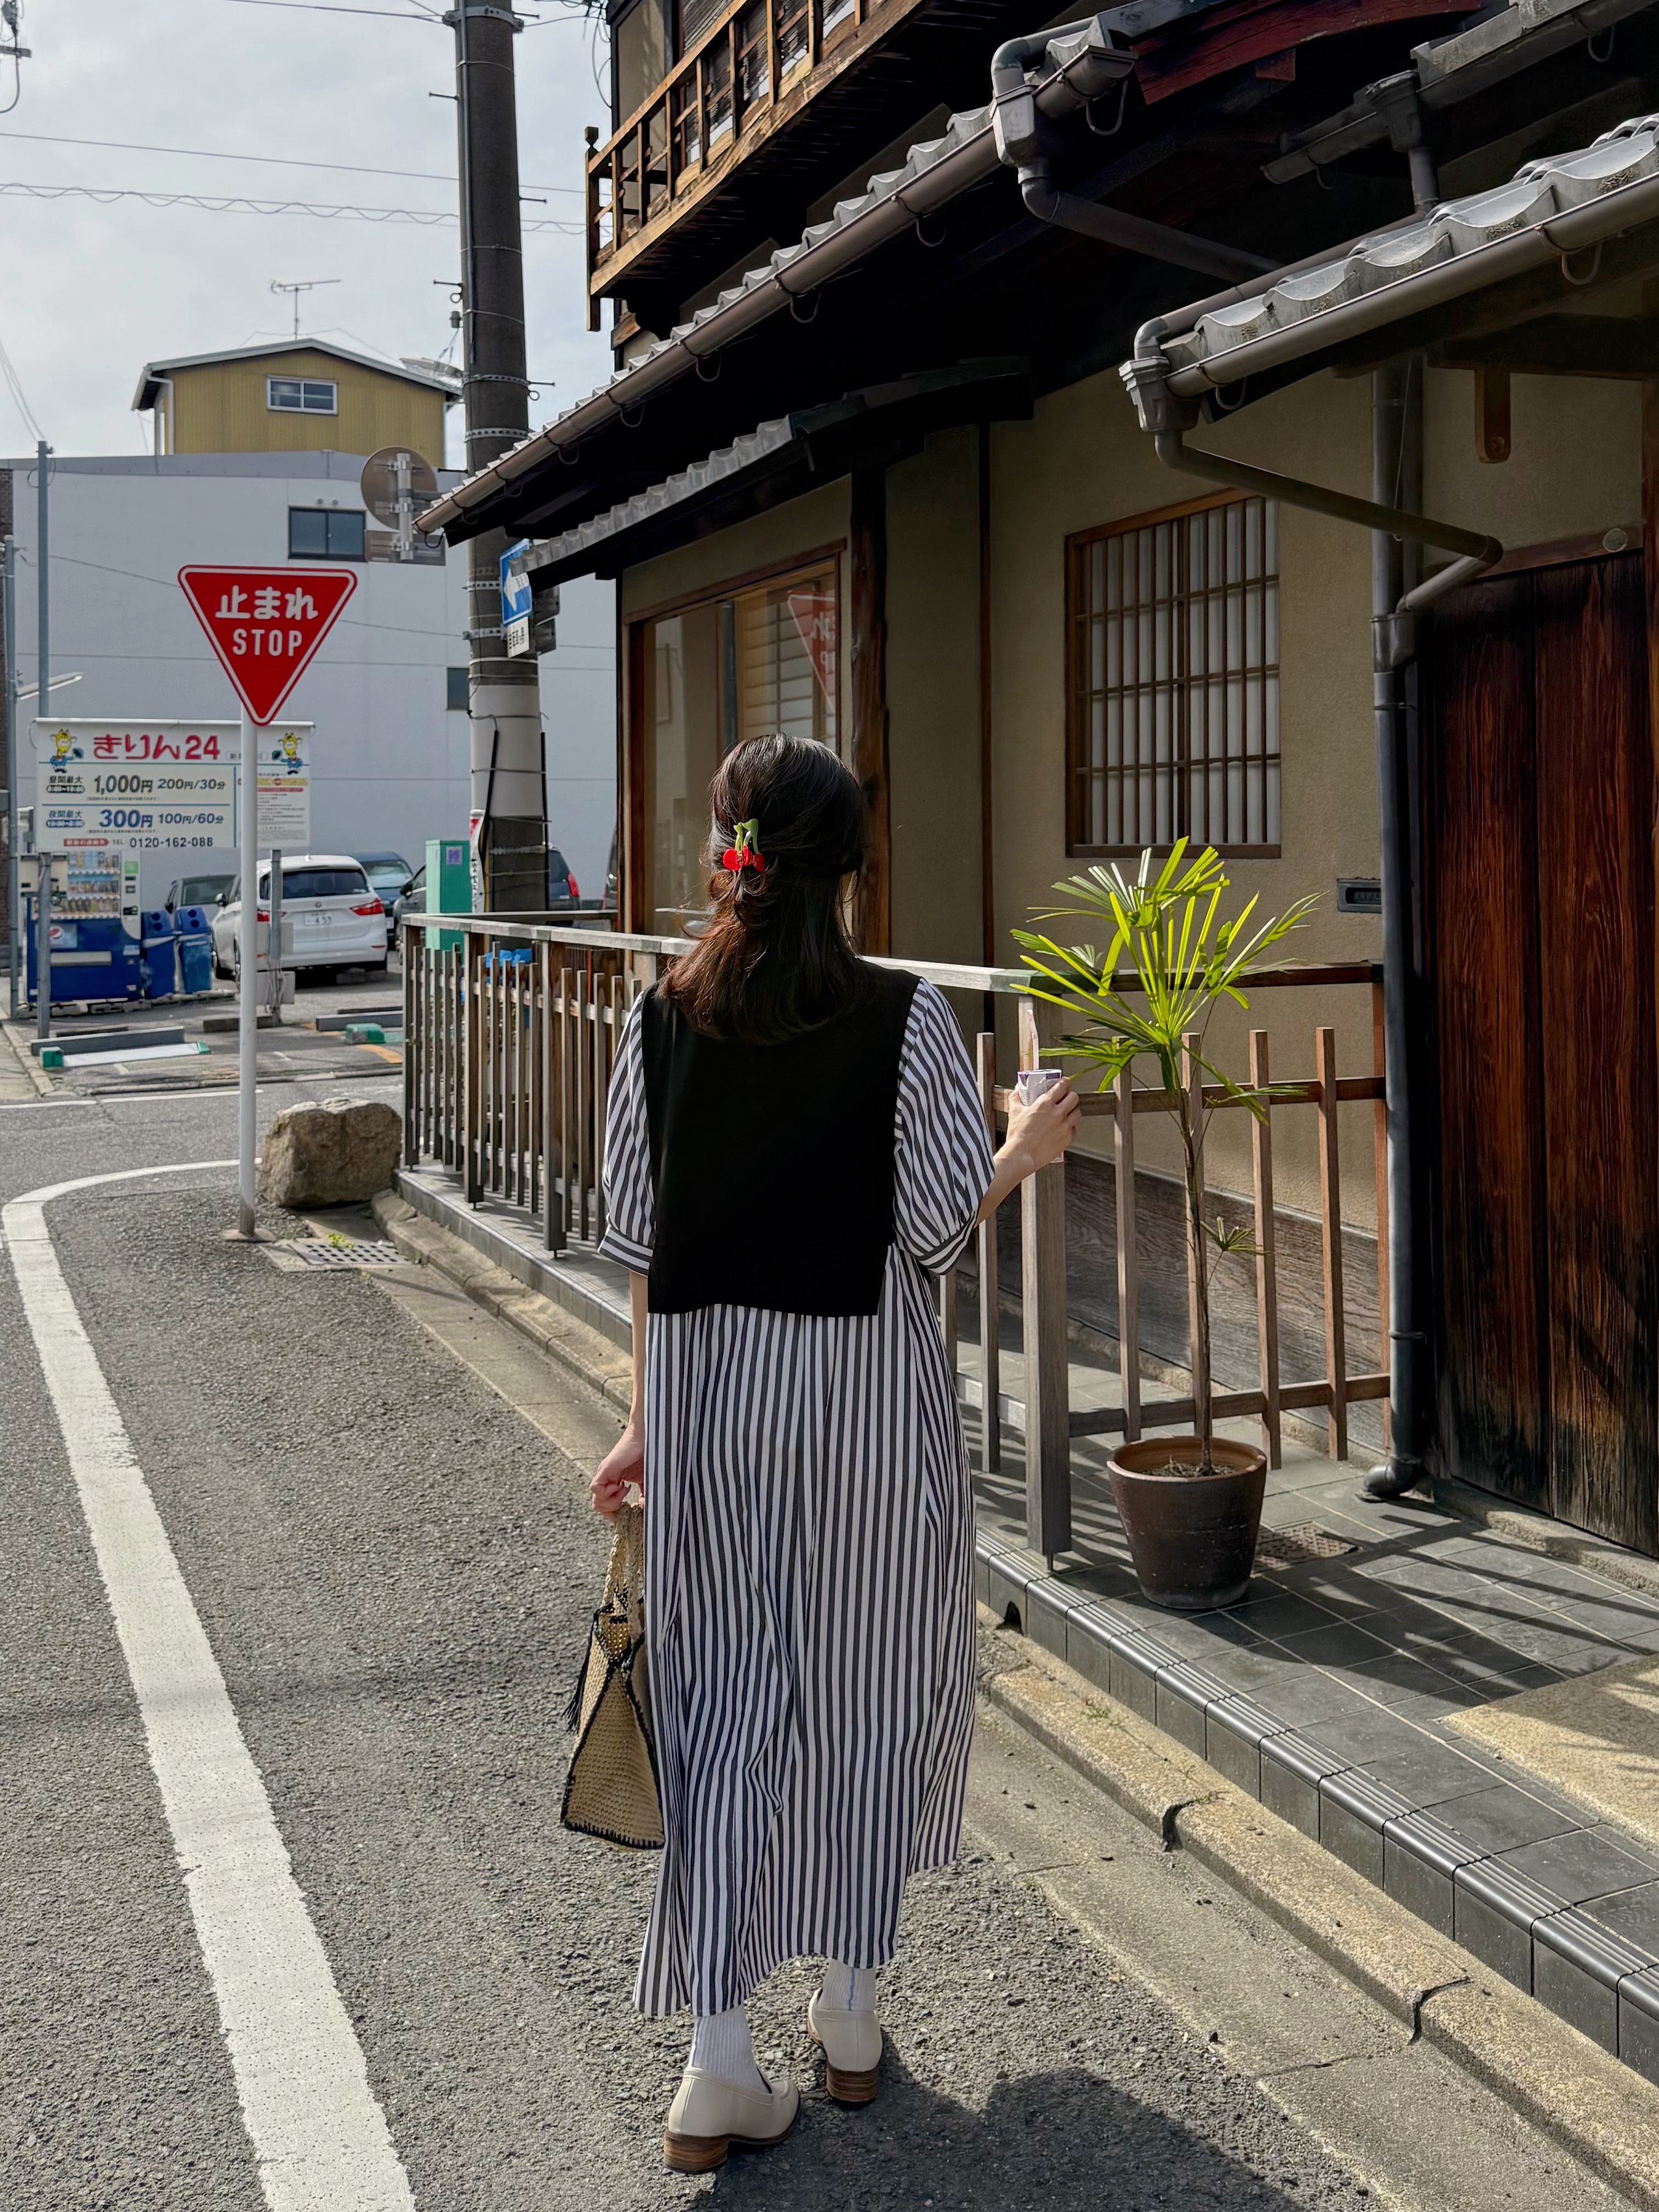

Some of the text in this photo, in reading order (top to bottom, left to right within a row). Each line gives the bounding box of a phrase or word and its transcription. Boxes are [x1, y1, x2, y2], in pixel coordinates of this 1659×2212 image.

[214, 585, 319, 620] 止まれ
[233, 629, 302, 657] STOP
[93, 734, 220, 760] きりん24
[94, 775, 226, 795] 1,000円 200円/30分
[99, 809, 224, 828] 300円 100円/60分
[129, 837, 213, 848] 0120-162-088
